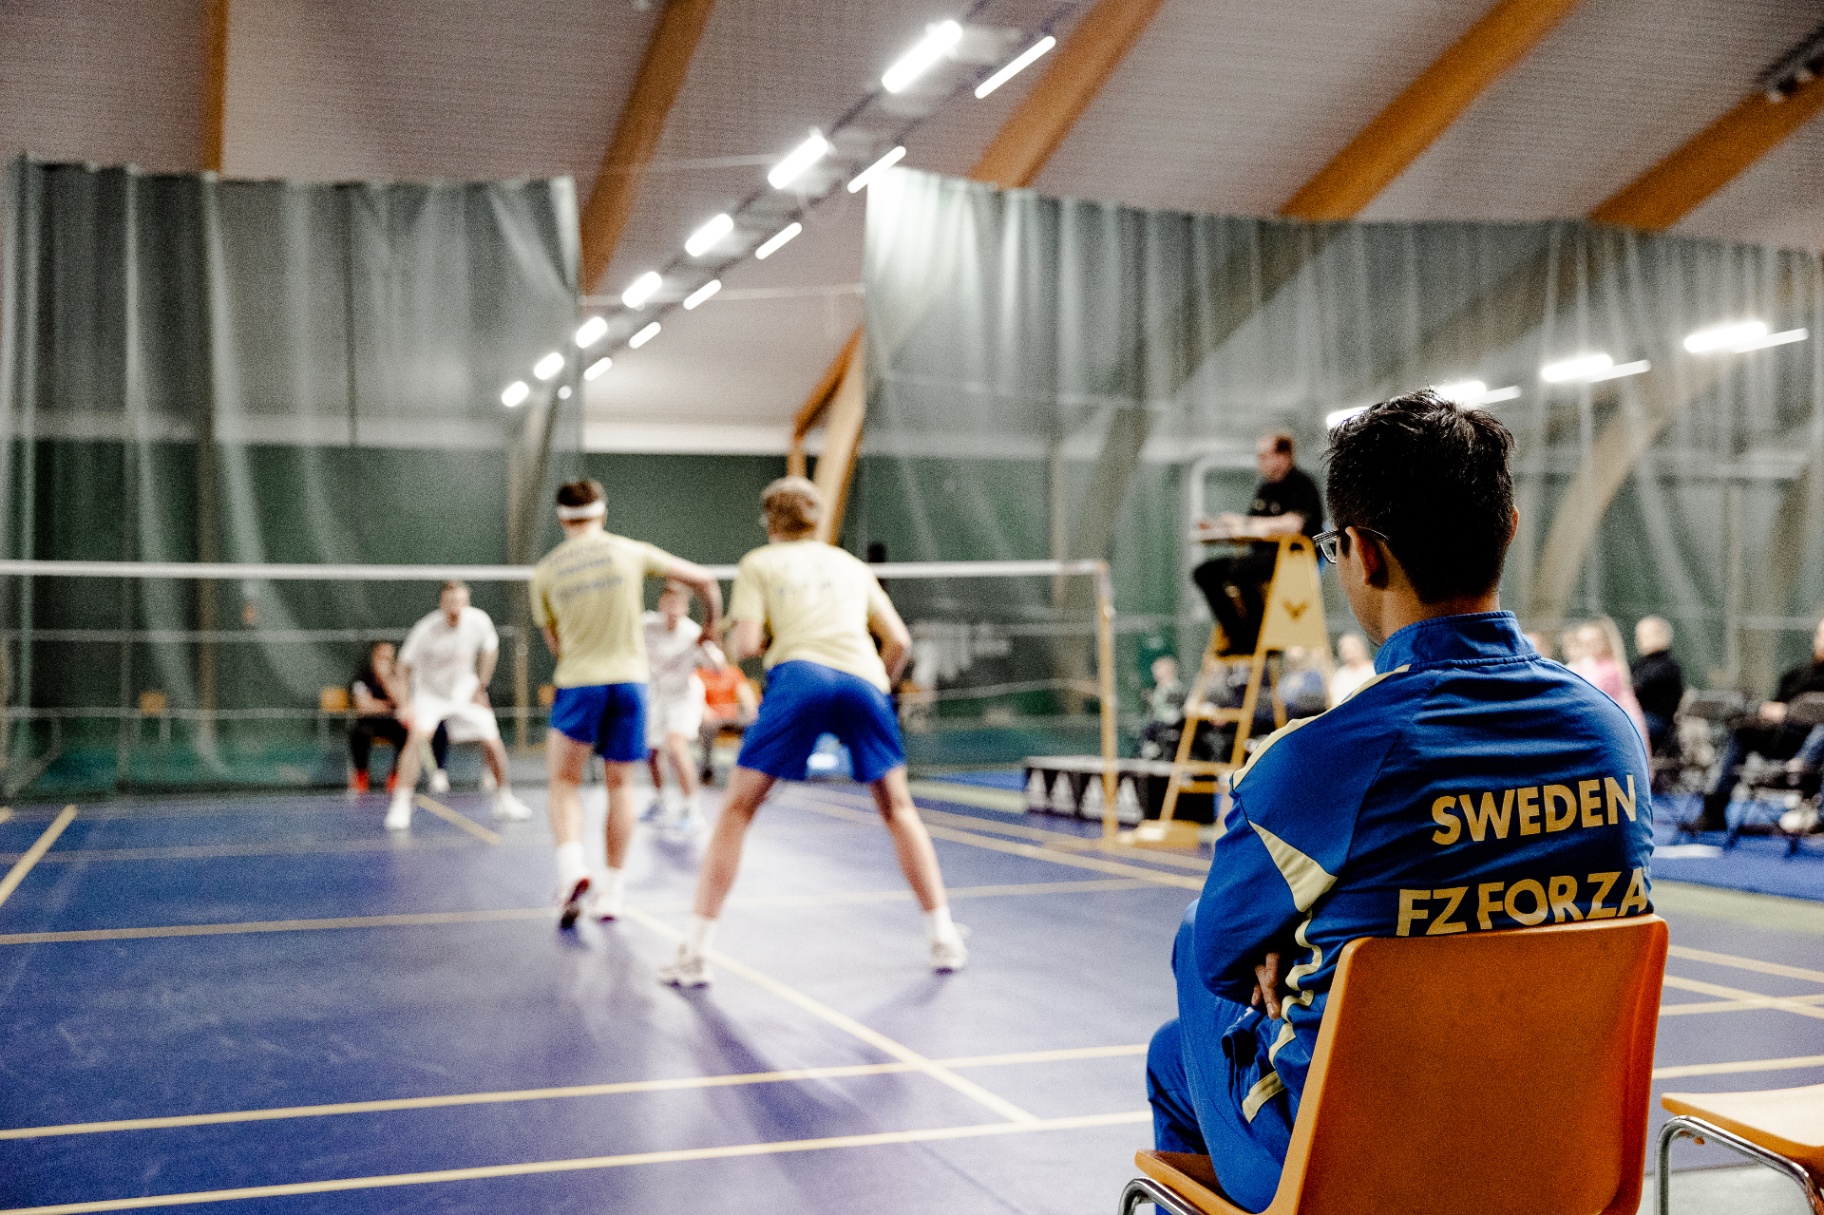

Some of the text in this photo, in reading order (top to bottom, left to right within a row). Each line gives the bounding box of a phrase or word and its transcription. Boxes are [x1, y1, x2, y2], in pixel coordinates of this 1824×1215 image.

[1431, 774, 1637, 846] SWEDEN
[1396, 866, 1650, 937] FZ FORZA
